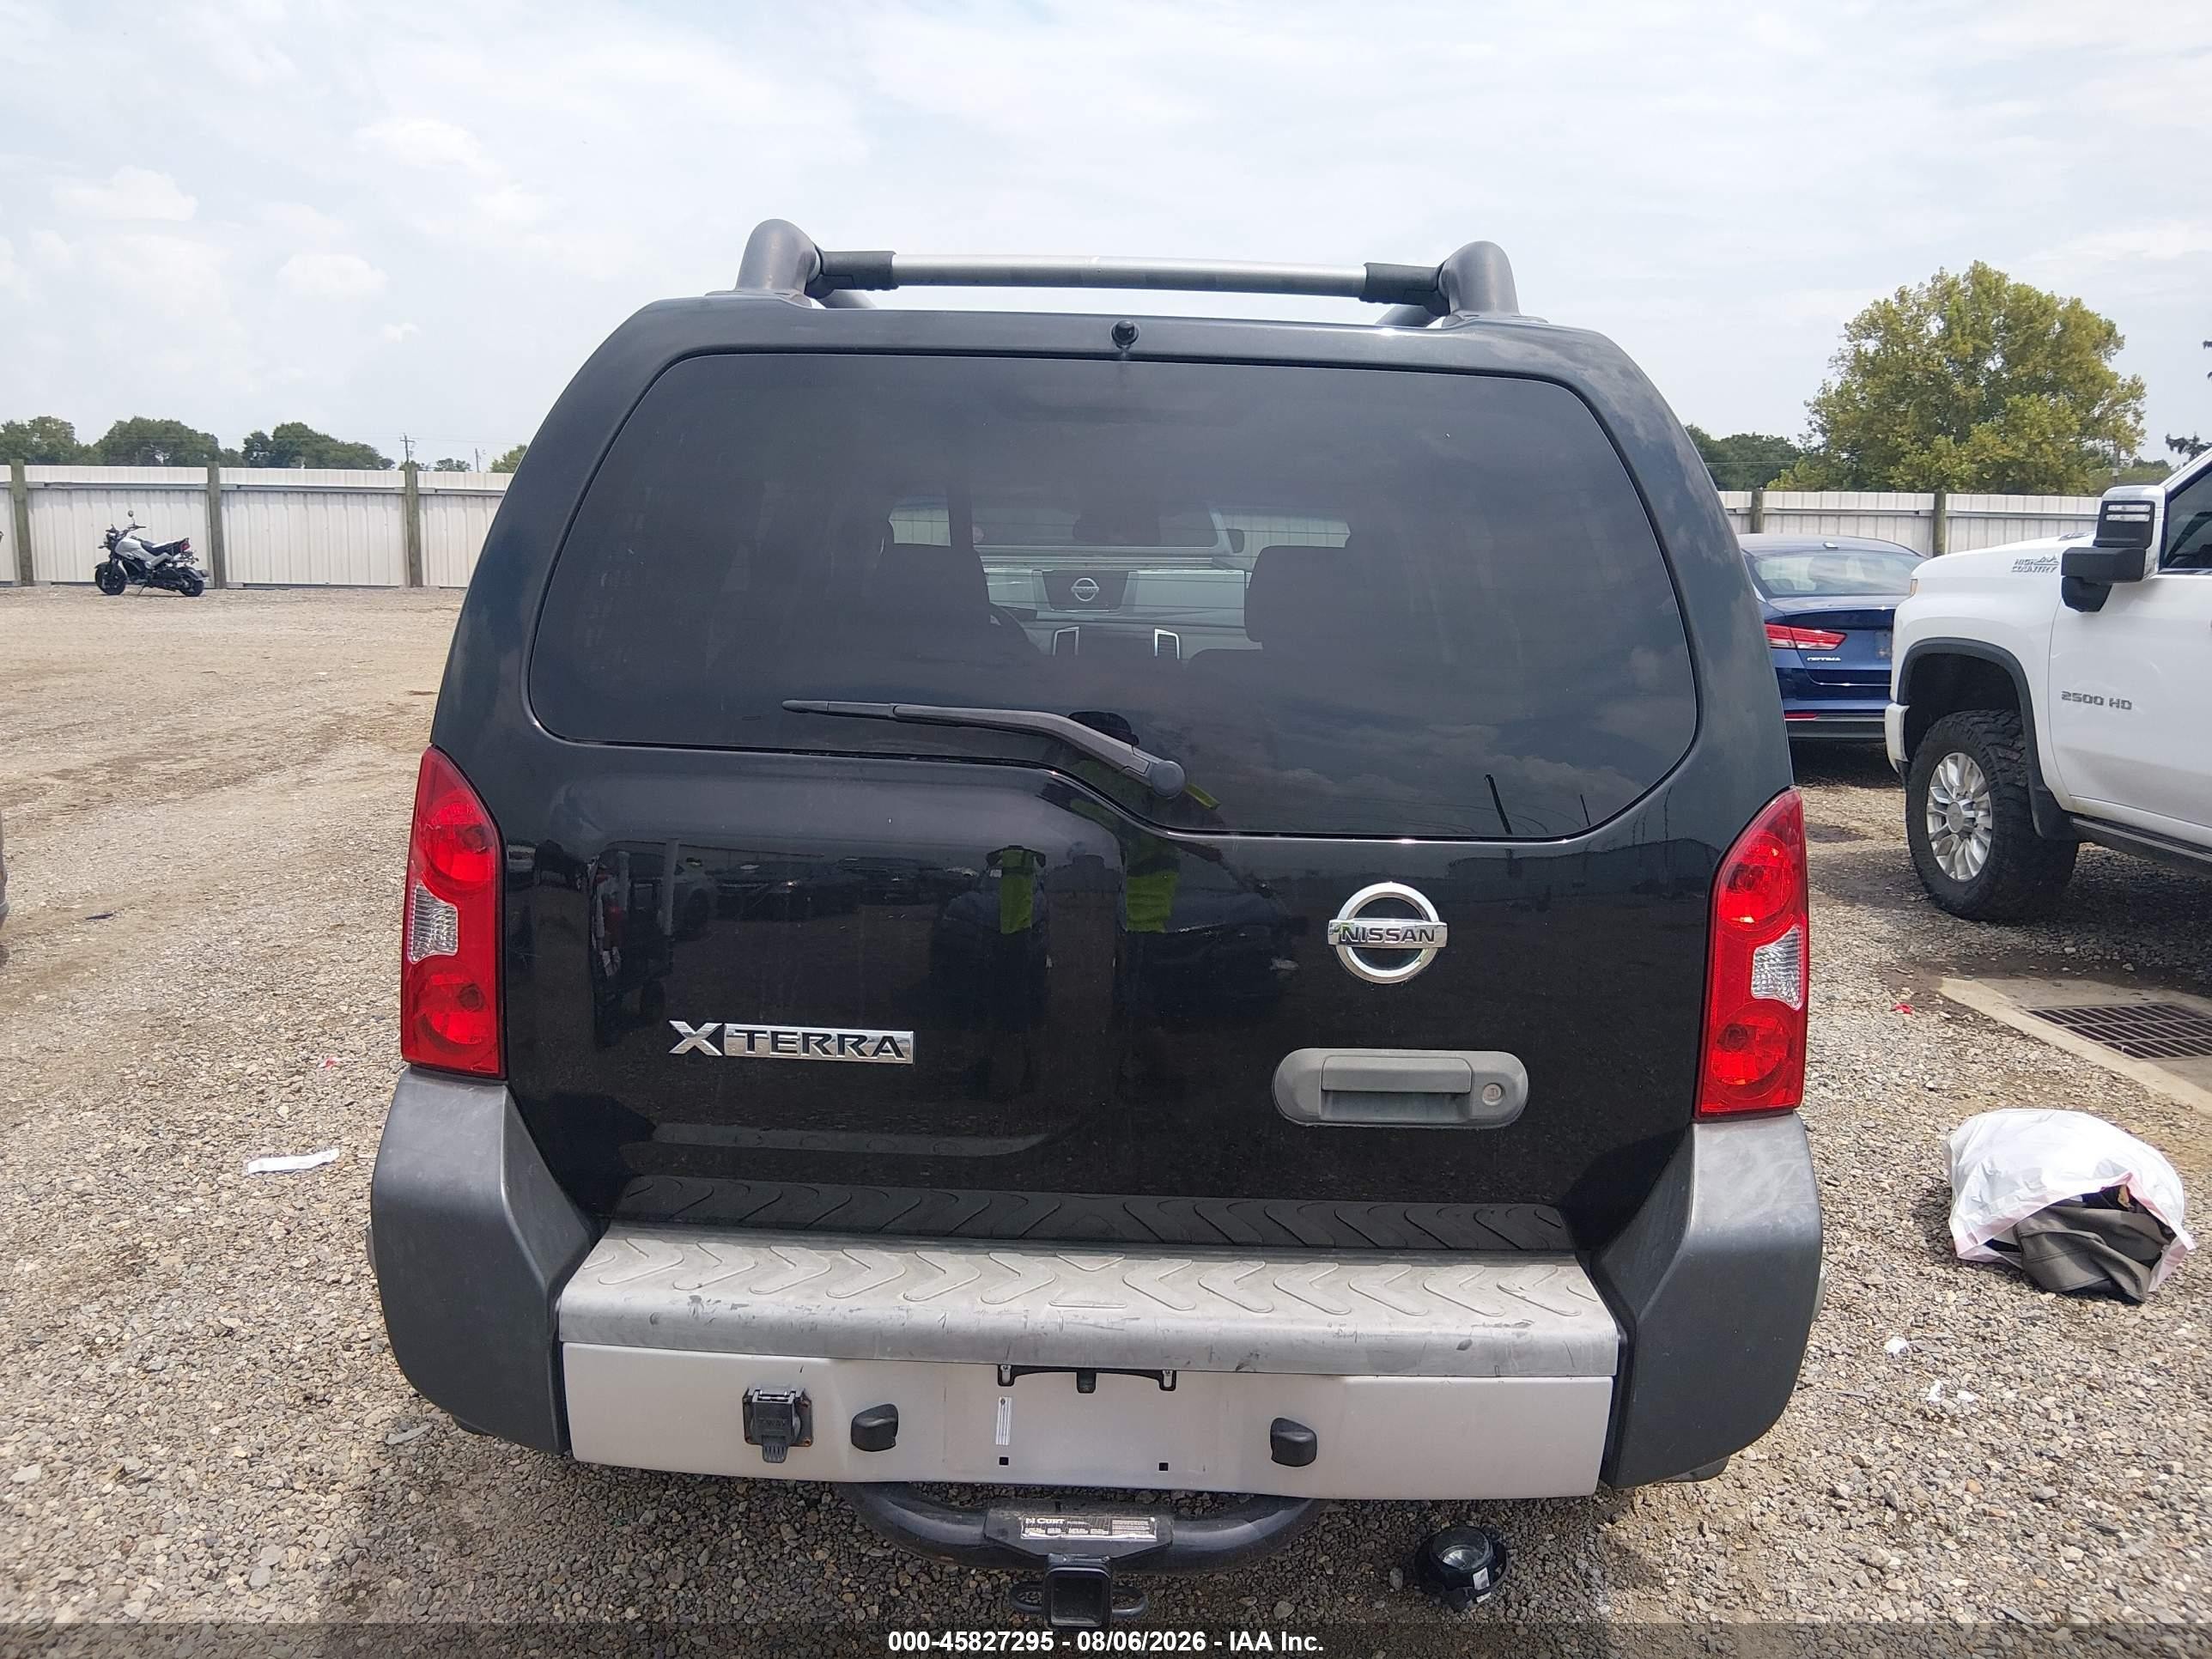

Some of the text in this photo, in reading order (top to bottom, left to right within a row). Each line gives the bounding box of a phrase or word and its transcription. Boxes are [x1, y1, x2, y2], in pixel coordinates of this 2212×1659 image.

[2061, 690, 2132, 710] 2500 HD
[1340, 927, 1436, 944] NISSAN
[668, 1019, 914, 1064] XTERRA
